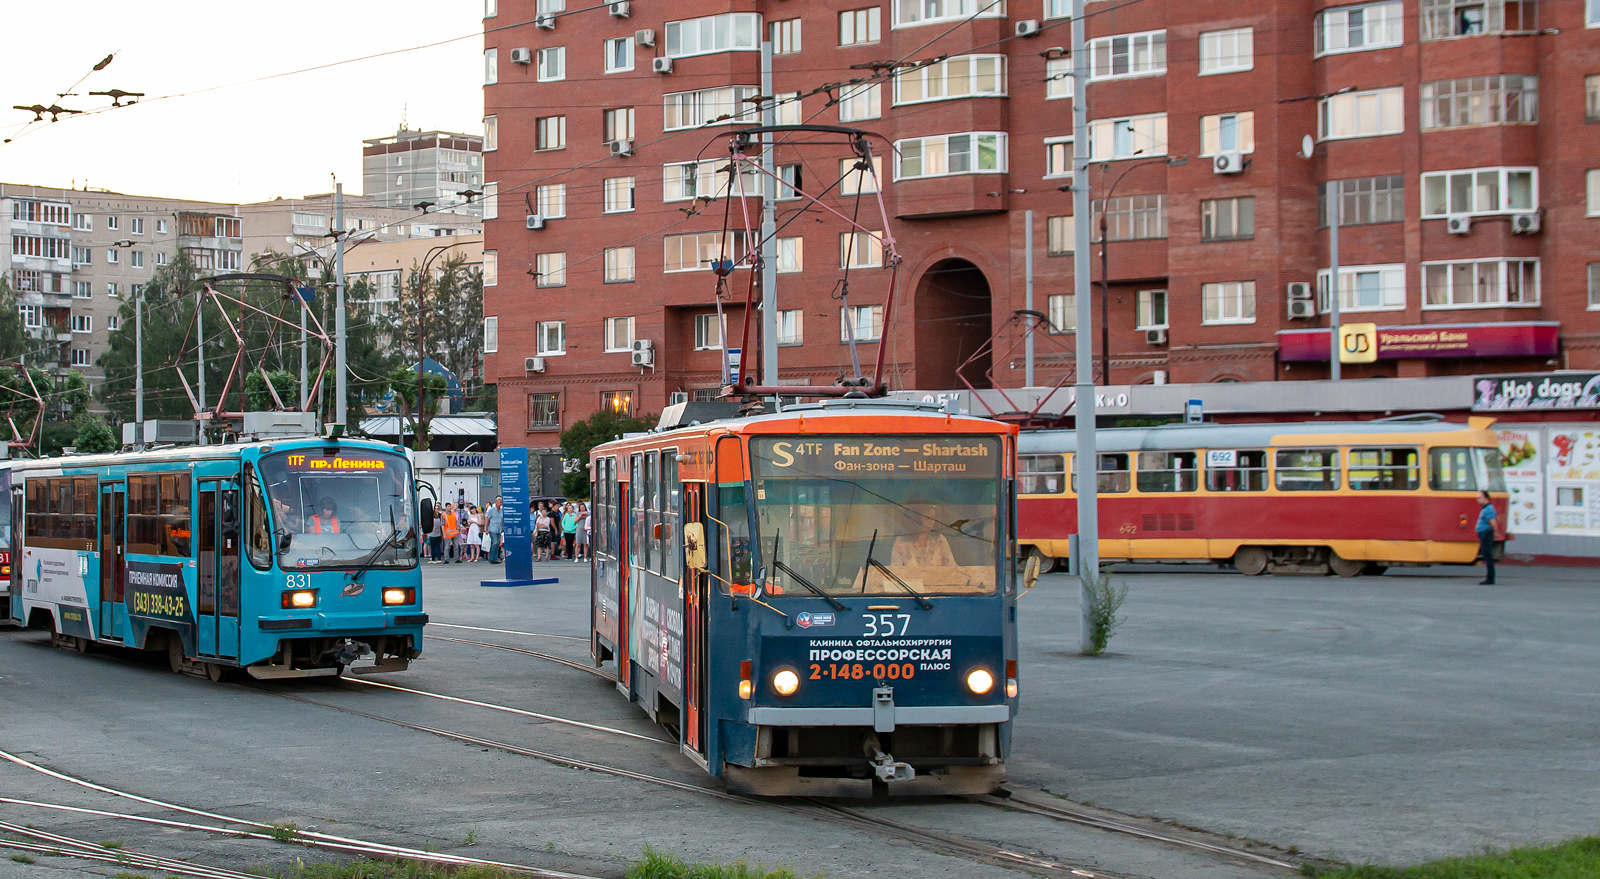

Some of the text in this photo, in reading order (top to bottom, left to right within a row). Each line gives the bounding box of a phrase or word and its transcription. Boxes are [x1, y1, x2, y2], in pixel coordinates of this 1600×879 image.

[1502, 377, 1583, 402] Hot dogs
[287, 455, 306, 466] 1TF
[447, 455, 484, 467] ТАБАКИ
[771, 441, 795, 468] S
[795, 443, 823, 455] 4TF
[834, 443, 861, 456] Fan
[863, 443, 900, 456] Zone
[923, 443, 988, 457] Shartash
[1211, 452, 1232, 462] 692
[833, 460, 895, 471] Фан-зона
[913, 460, 966, 473] Шарташ
[1119, 525, 1138, 534] 692
[286, 574, 311, 588] 831
[133, 591, 184, 617] (343) 338-43-25
[862, 613, 911, 637] 357
[855, 639, 952, 647] ОФТАЛЬМОХИРУРГИИ
[809, 648, 952, 661] ПРОФЕССОРСКАЯ
[920, 662, 951, 671] ПЛЮС
